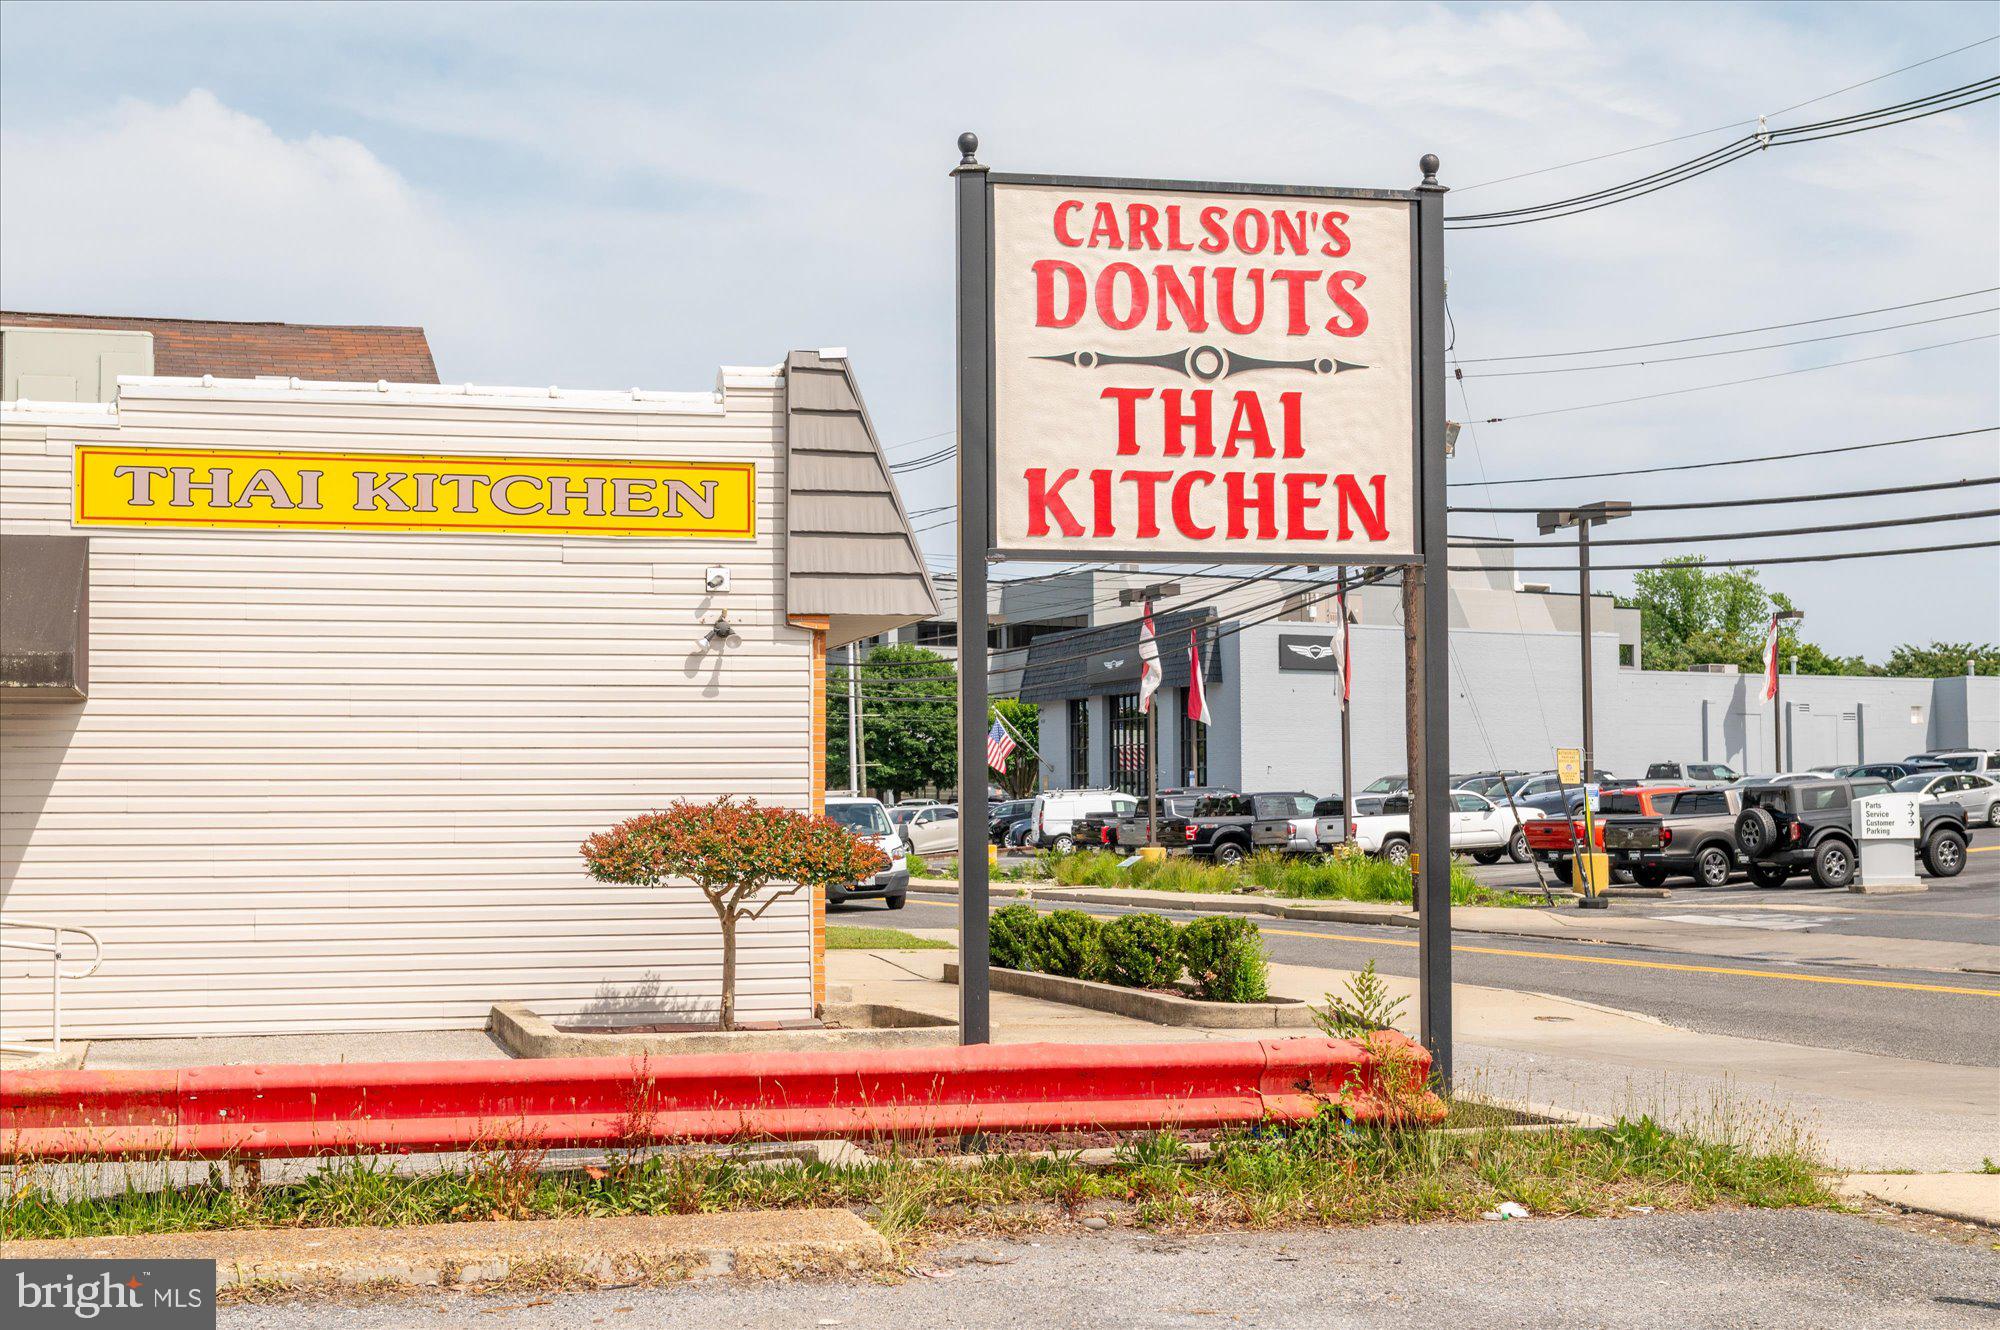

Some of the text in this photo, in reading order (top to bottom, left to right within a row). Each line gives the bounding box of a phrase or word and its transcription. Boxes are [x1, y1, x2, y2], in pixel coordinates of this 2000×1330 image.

[1053, 199, 1352, 258] CARLSON'S
[1032, 259, 1370, 338] DONUTS
[1100, 387, 1306, 459] THAI
[114, 465, 719, 520] THAI KITCHEN
[1023, 467, 1391, 541] KITCHEN
[1865, 801, 1881, 809] Parts
[1865, 810, 1890, 818] Service
[1866, 819, 1895, 827] Customer
[1866, 827, 1890, 835] Parking
